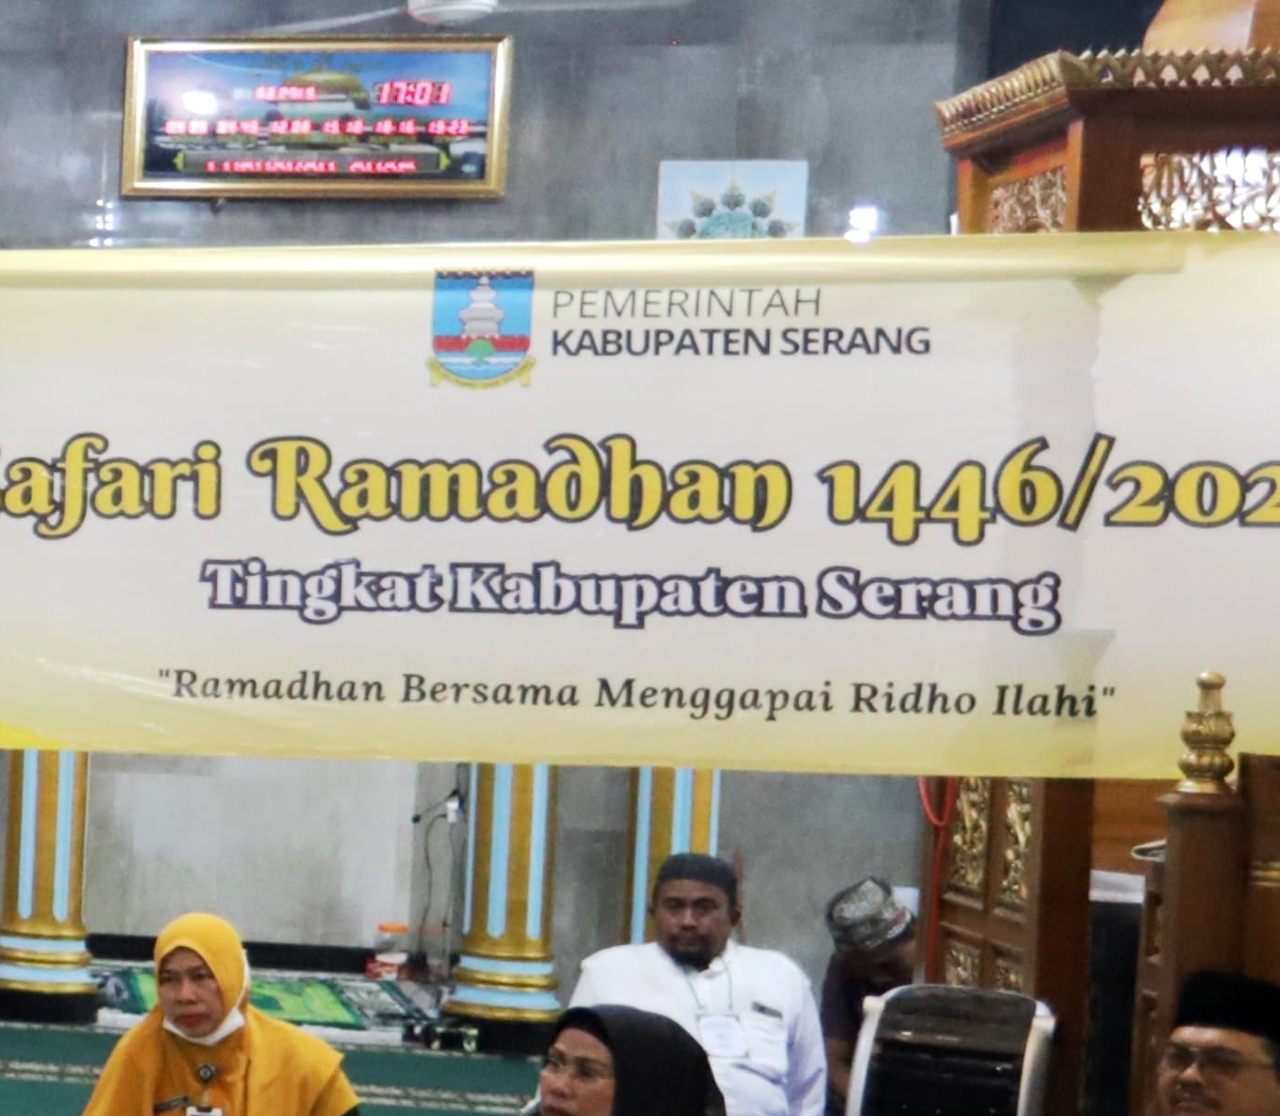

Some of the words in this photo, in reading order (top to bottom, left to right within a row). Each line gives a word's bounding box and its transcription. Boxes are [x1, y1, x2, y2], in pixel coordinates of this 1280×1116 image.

[377, 81, 453, 107] 17:01
[552, 287, 822, 319] PEMERINTAH
[552, 328, 771, 357] KABUPATEN
[781, 326, 931, 356] SERANG
[247, 431, 793, 536] Ramadhan
[200, 556, 445, 625] Tingkat
[449, 560, 807, 630] Kabupaten
[816, 567, 1062, 636] Serang
[158, 667, 386, 704] "Ramadhan
[401, 672, 579, 708] Bersama
[595, 676, 834, 720] Menggapai
[852, 679, 976, 717] Ridho
[992, 684, 1116, 718] Ilahi"
